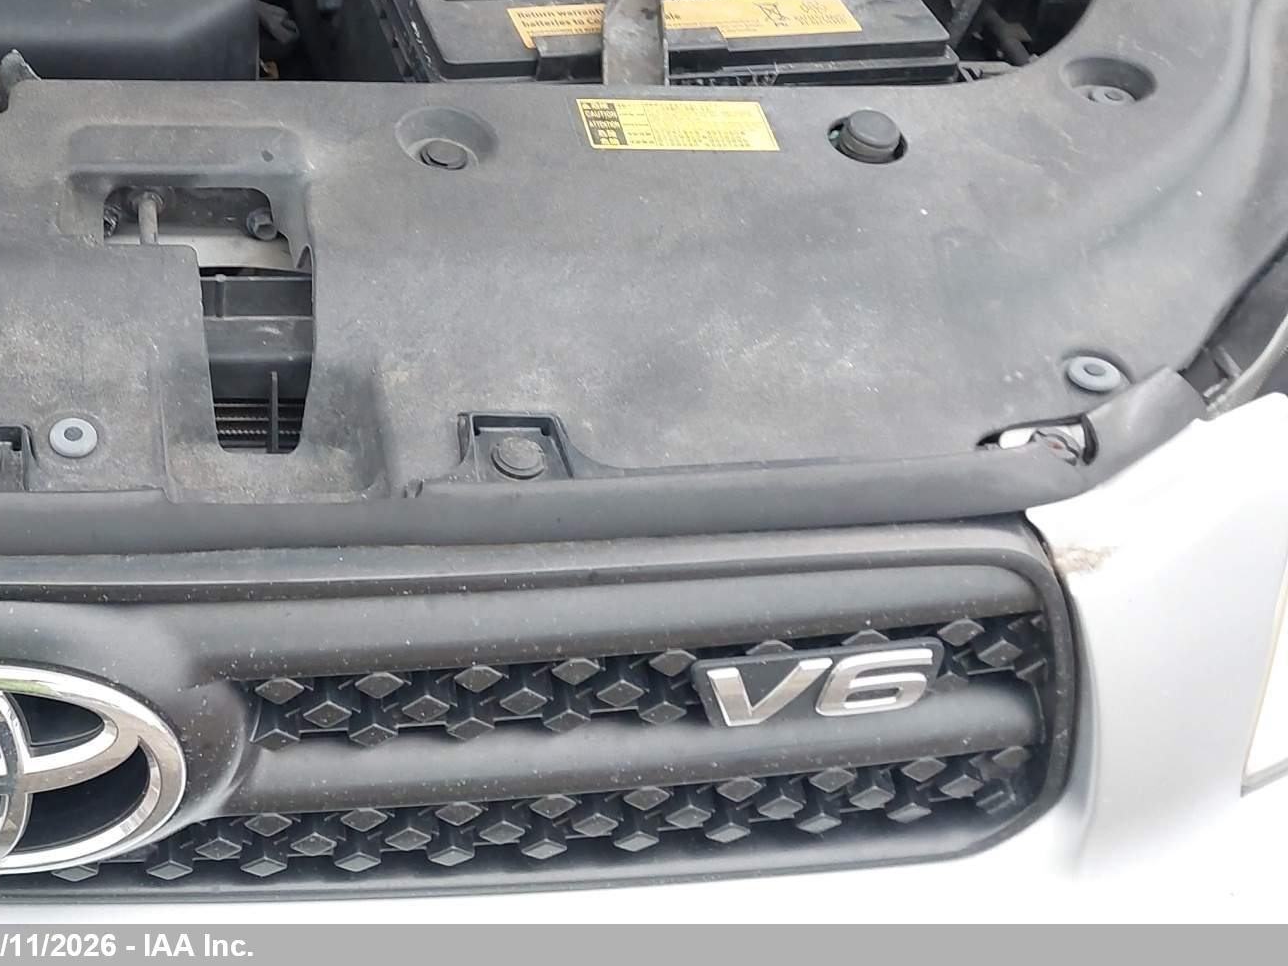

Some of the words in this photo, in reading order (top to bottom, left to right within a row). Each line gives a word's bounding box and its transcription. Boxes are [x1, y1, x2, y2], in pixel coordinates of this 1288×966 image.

[516, 9, 556, 19] Return
[584, 110, 618, 120] CAUTION
[589, 120, 621, 130] ATTENTION
[706, 648, 933, 727] V6
